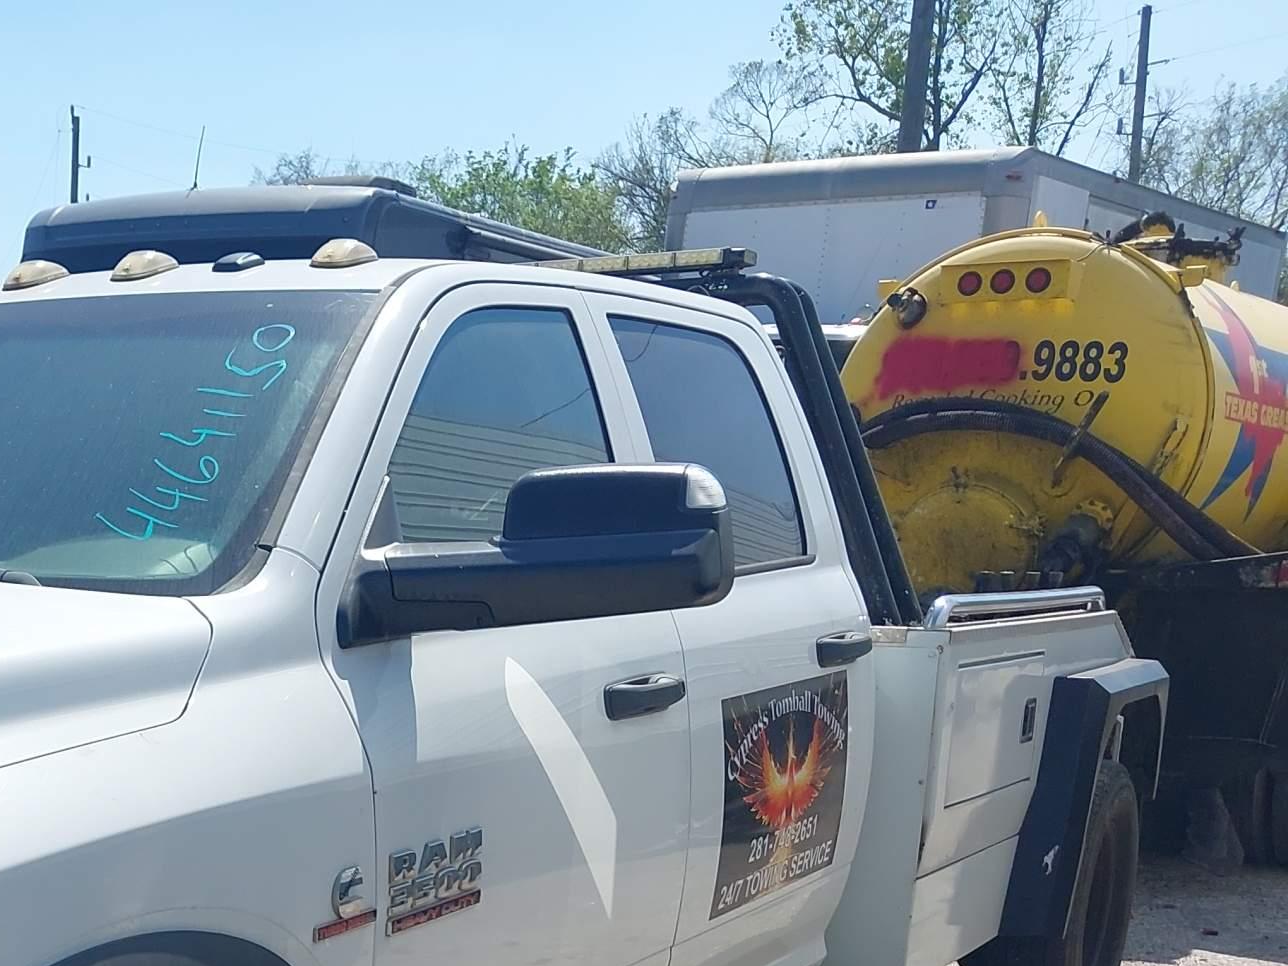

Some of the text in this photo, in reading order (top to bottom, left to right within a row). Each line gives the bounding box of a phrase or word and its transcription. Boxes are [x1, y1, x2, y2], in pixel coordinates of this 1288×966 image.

[94, 323, 296, 542] 44641150
[1225, 395, 1258, 424] TEXAS
[727, 690, 847, 782] Cypress Tomball Towing
[388, 825, 483, 883] RAM
[717, 839, 833, 910] 24/7 TOWING SERVICE
